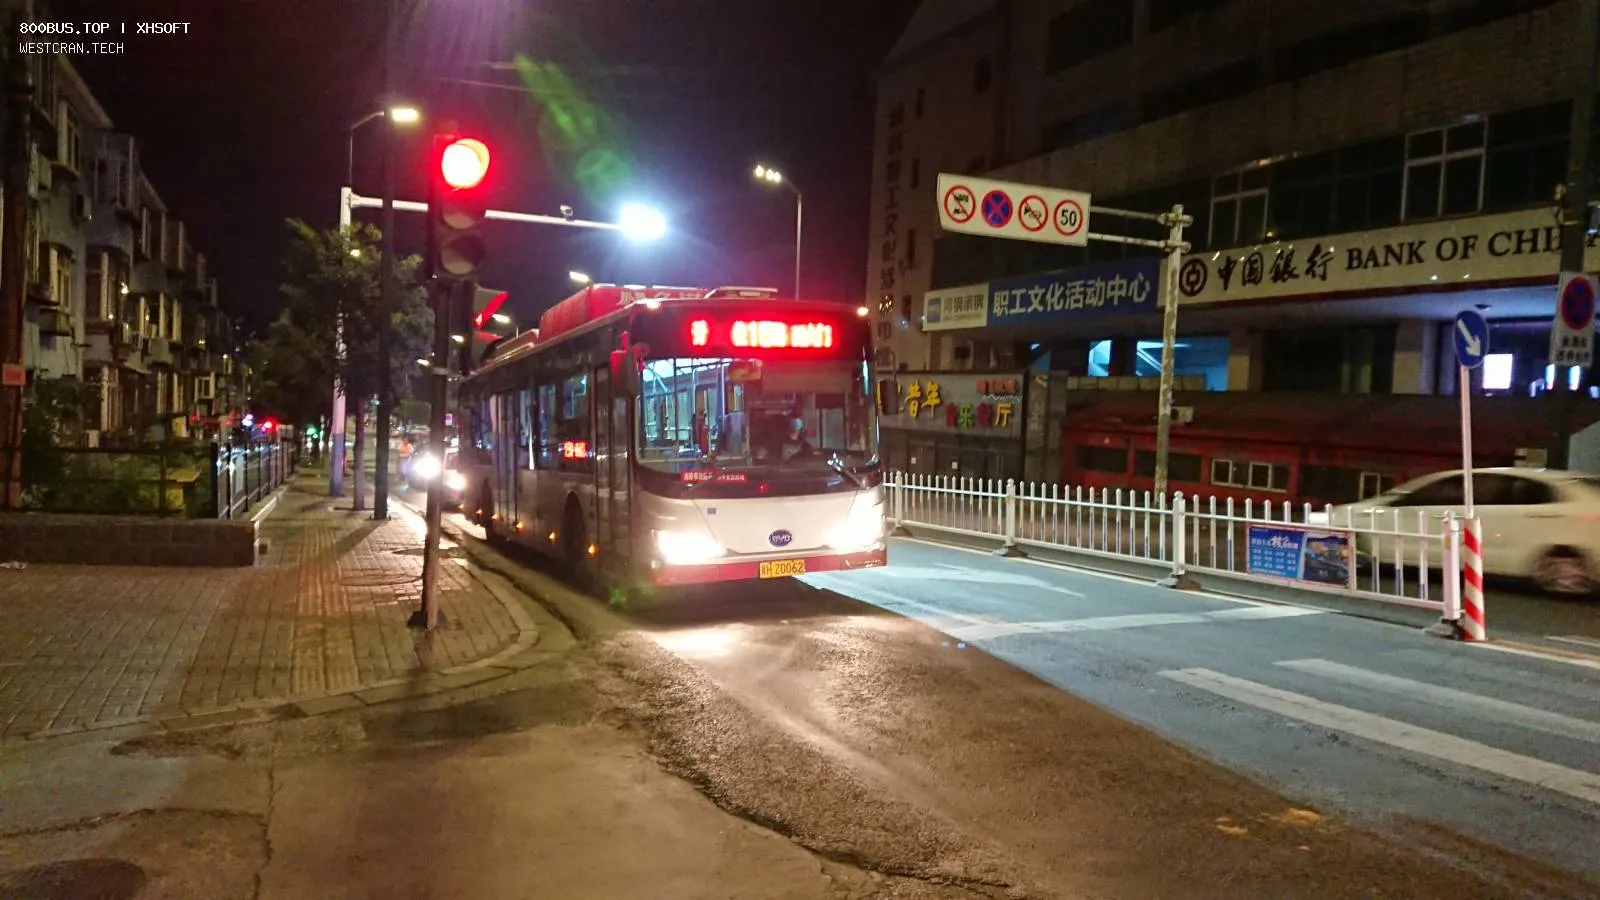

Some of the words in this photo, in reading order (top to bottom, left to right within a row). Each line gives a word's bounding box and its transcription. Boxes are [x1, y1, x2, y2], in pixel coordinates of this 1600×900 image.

[1059, 208, 1078, 228] 50
[1346, 239, 1426, 271] BANK
[1435, 235, 1479, 262] OF
[1487, 224, 1600, 258] CHI
[992, 271, 1150, 317] 职工文化活动中心
